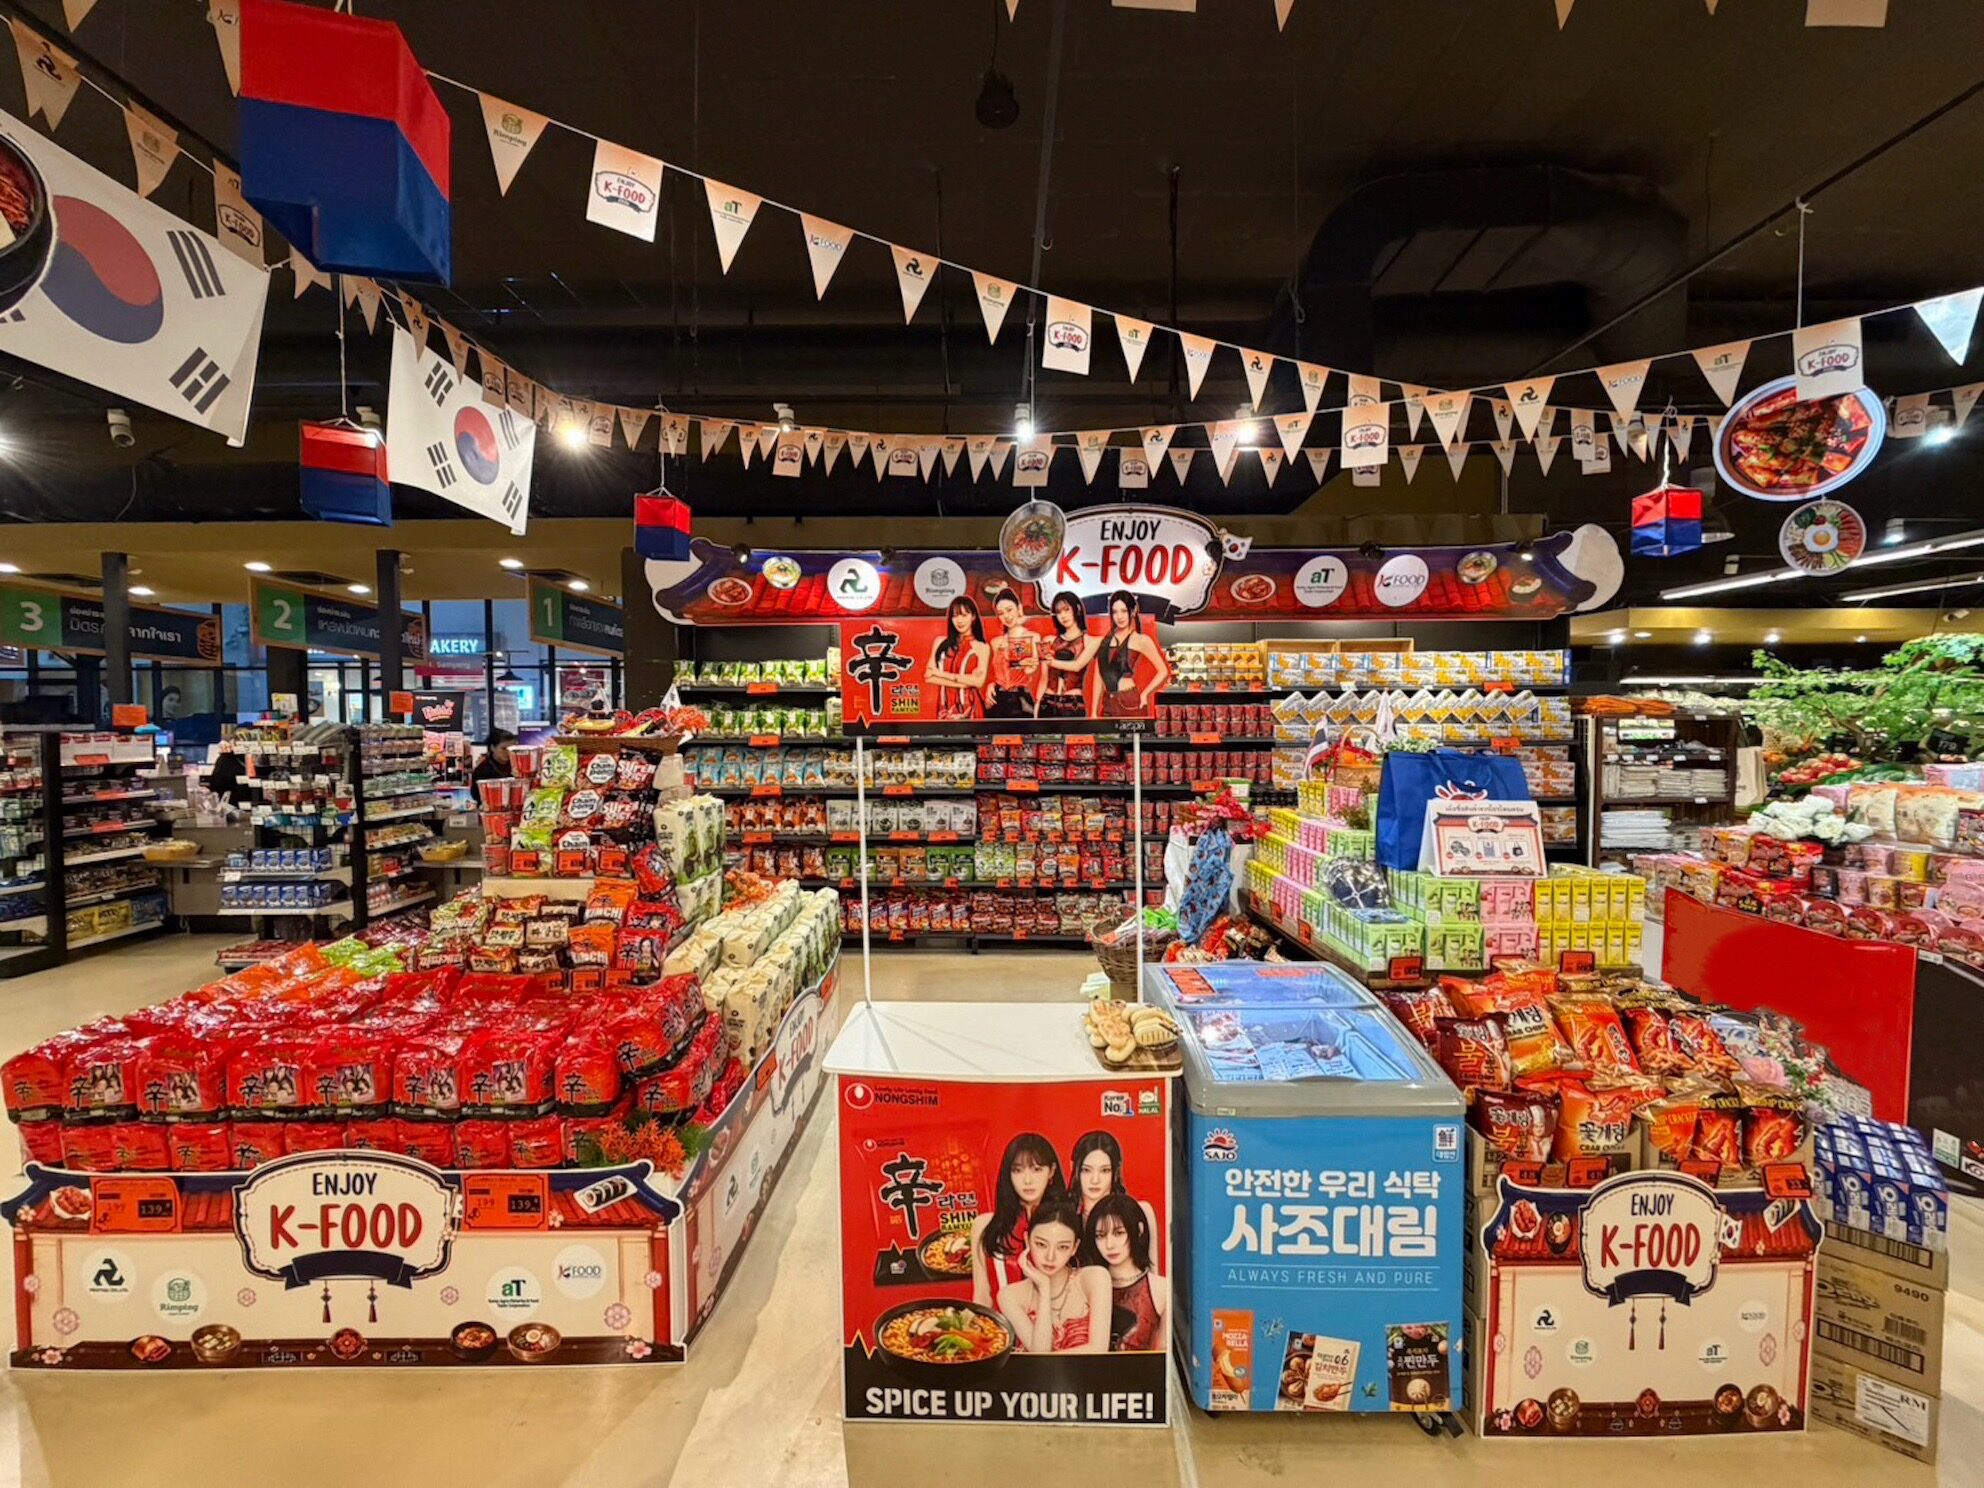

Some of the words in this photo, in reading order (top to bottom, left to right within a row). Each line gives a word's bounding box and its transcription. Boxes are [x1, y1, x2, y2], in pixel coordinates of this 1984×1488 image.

[603, 181, 646, 204] K-FOOD
[1053, 331, 1083, 345] K-FOOD
[1807, 353, 1850, 369] K-FOOD
[1350, 430, 1380, 442] K-FOOD
[1100, 519, 1160, 541] ENJOY
[1056, 544, 1194, 585] K-FOOD
[1311, 567, 1334, 584] aT
[19, 601, 43, 632] 3
[273, 599, 292, 630] 2
[543, 598, 553, 627] 1
[430, 639, 478, 654] AKERY
[849, 626, 914, 717] 辛
[891, 697, 919, 707] SHIN
[590, 762, 614, 770] Cham
[562, 840, 587, 848] Cham
[586, 907, 623, 919] KIMCHI
[571, 951, 608, 964] KIMCHI
[778, 1016, 814, 1082] K-FOOD
[70, 1076, 91, 1110] 辛
[146, 1081, 169, 1114] 辛
[240, 1076, 264, 1108] 辛
[316, 1076, 338, 1108] 辛
[405, 1074, 426, 1106] 辛
[471, 1073, 494, 1105] 辛
[562, 1073, 586, 1105] 辛
[874, 1092, 938, 1105] NONGSHIM
[1489, 1106, 1531, 1127] 꽃게랑
[1579, 1122, 1626, 1144] 꽃게랑
[1204, 1151, 1236, 1160] SAJO
[1579, 1144, 1600, 1152] CRAB
[313, 1172, 377, 1196] ENJOY
[1225, 1168, 1312, 1198] 안전한
[1318, 1170, 1375, 1199] 우리
[1383, 1170, 1441, 1199] 식탁
[511, 1200, 531, 1210] 139
[881, 1152, 944, 1239] 辛
[936, 1192, 977, 1208] 라면
[1631, 1193, 1674, 1216] ENJOY
[270, 1203, 422, 1249] K-FOOD
[940, 1211, 977, 1224] SHIN
[941, 1223, 973, 1231] RAMYU
[1221, 1203, 1438, 1257] 사조대림
[1601, 1223, 1700, 1268] K-FOOD
[1228, 1268, 1290, 1282] ALWAYS
[1298, 1270, 1347, 1284] FRESH
[1355, 1271, 1386, 1284] AND
[1394, 1271, 1433, 1285] PURE
[502, 1280, 526, 1296] aT
[1893, 1283, 1930, 1303] 9490
[160, 1302, 198, 1314] Rimping
[1222, 1332, 1247, 1341] MOZZA
[866, 1387, 947, 1416] SPICE
[954, 1389, 993, 1417] UP
[1000, 1391, 1078, 1419] YOUR
[1086, 1392, 1154, 1420] LIFE!
[1900, 1393, 1926, 1411] RM
